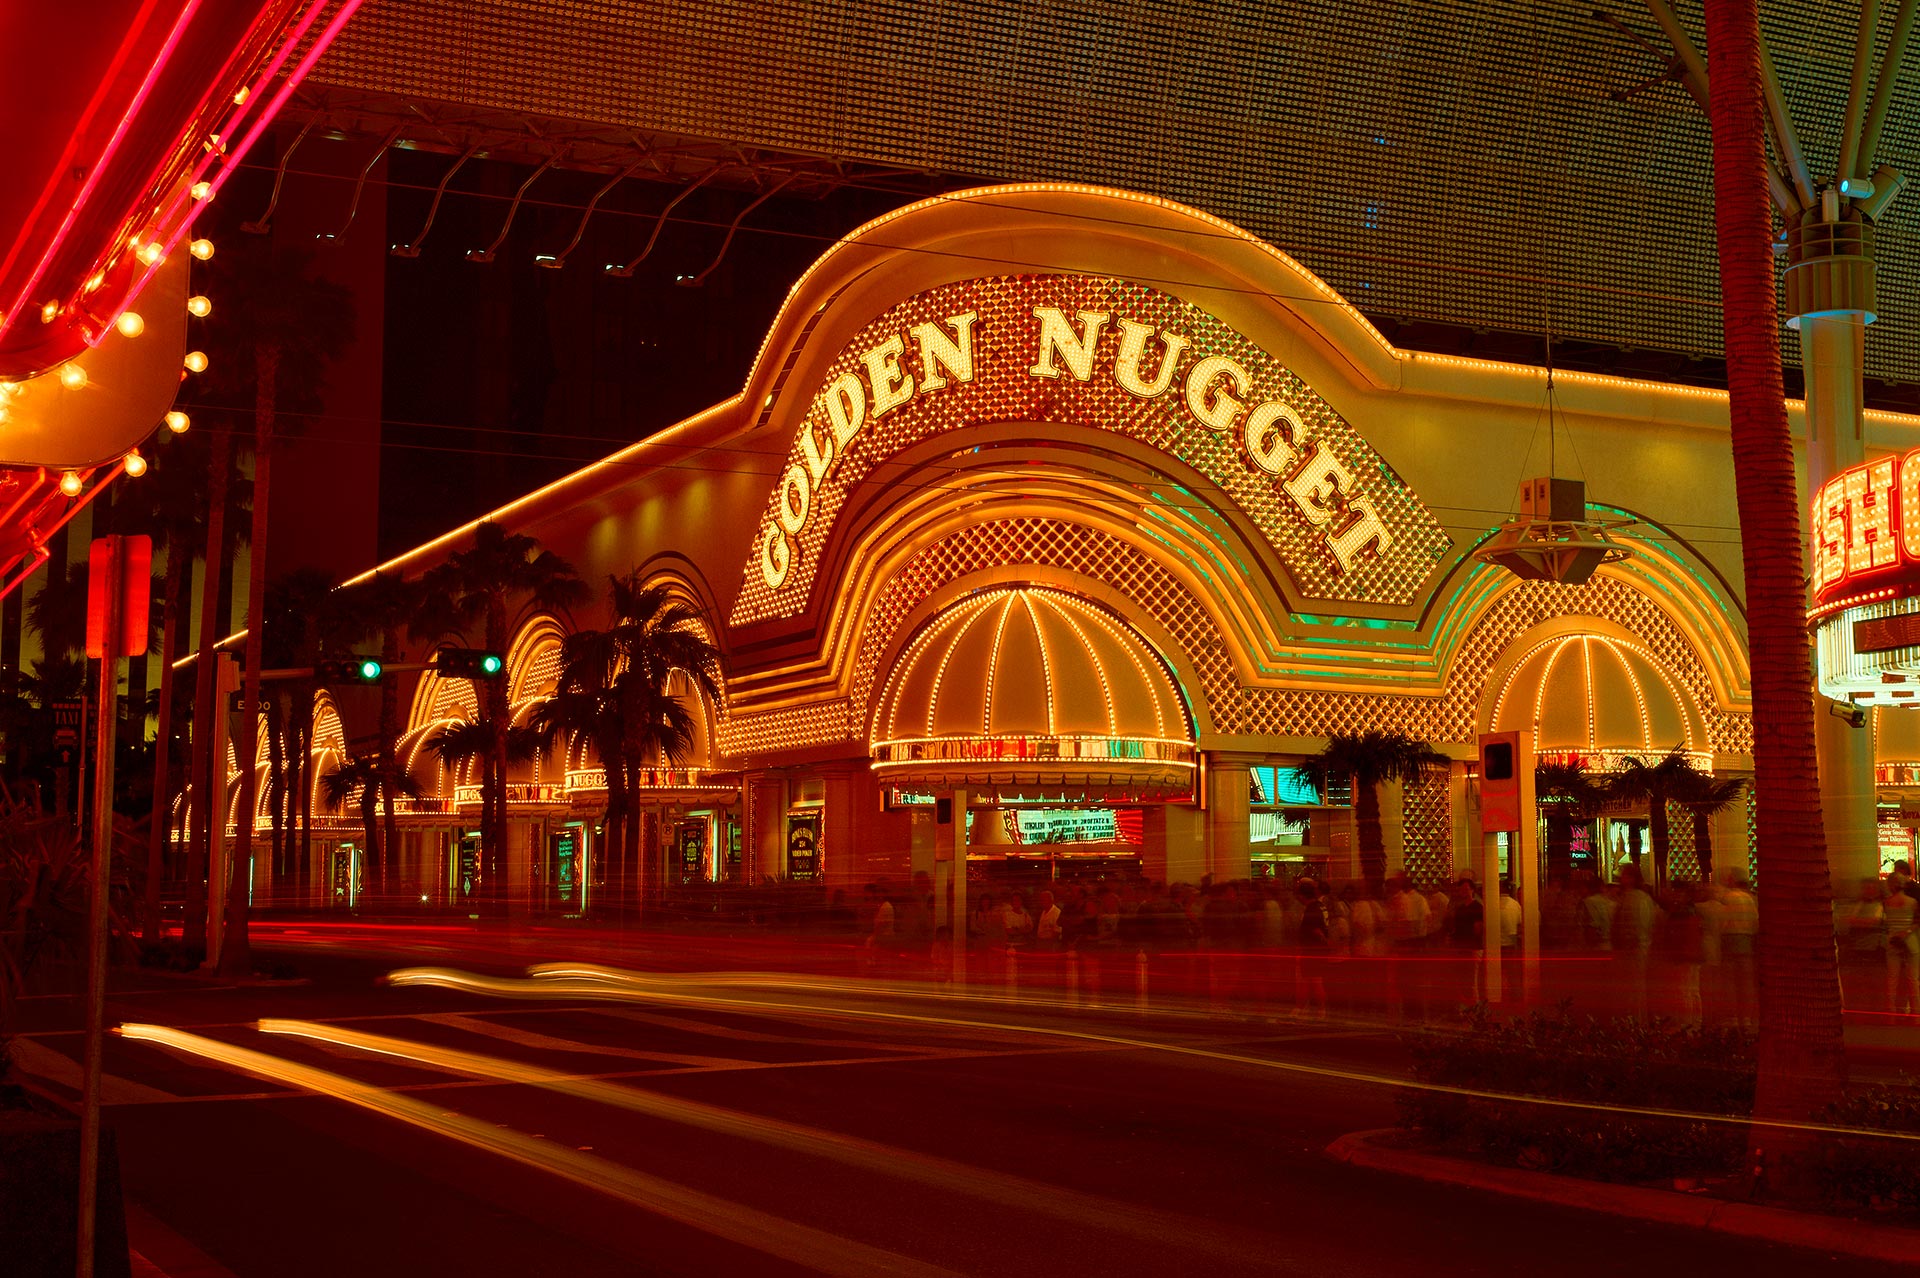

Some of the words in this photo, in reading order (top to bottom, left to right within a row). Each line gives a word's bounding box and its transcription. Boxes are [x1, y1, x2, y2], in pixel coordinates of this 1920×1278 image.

[761, 310, 979, 590] GOLDEN
[1029, 306, 1394, 574] NUGGET
[55, 711, 79, 725] TAXI
